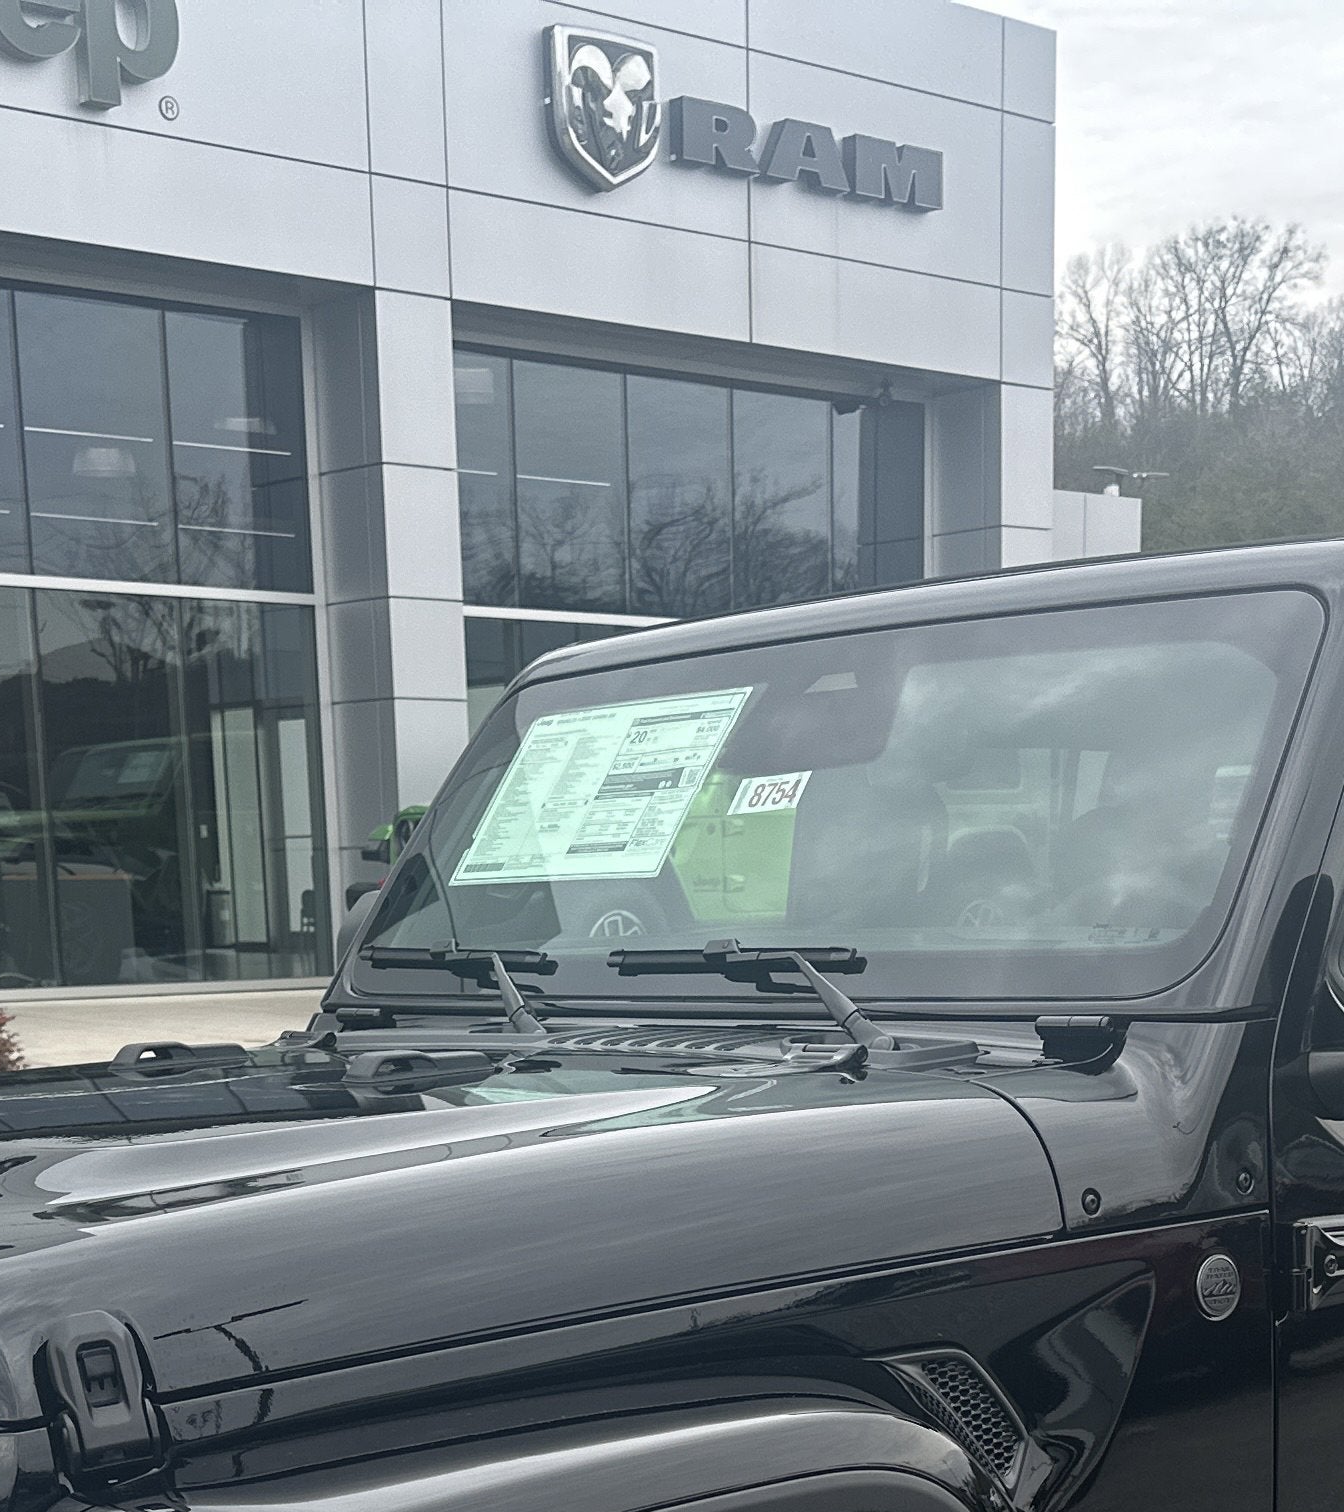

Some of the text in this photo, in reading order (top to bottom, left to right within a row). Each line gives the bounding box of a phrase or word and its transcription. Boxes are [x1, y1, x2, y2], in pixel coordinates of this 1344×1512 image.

[670, 95, 944, 210] RAM
[630, 730, 649, 745] 20
[748, 778, 802, 808] 8754
